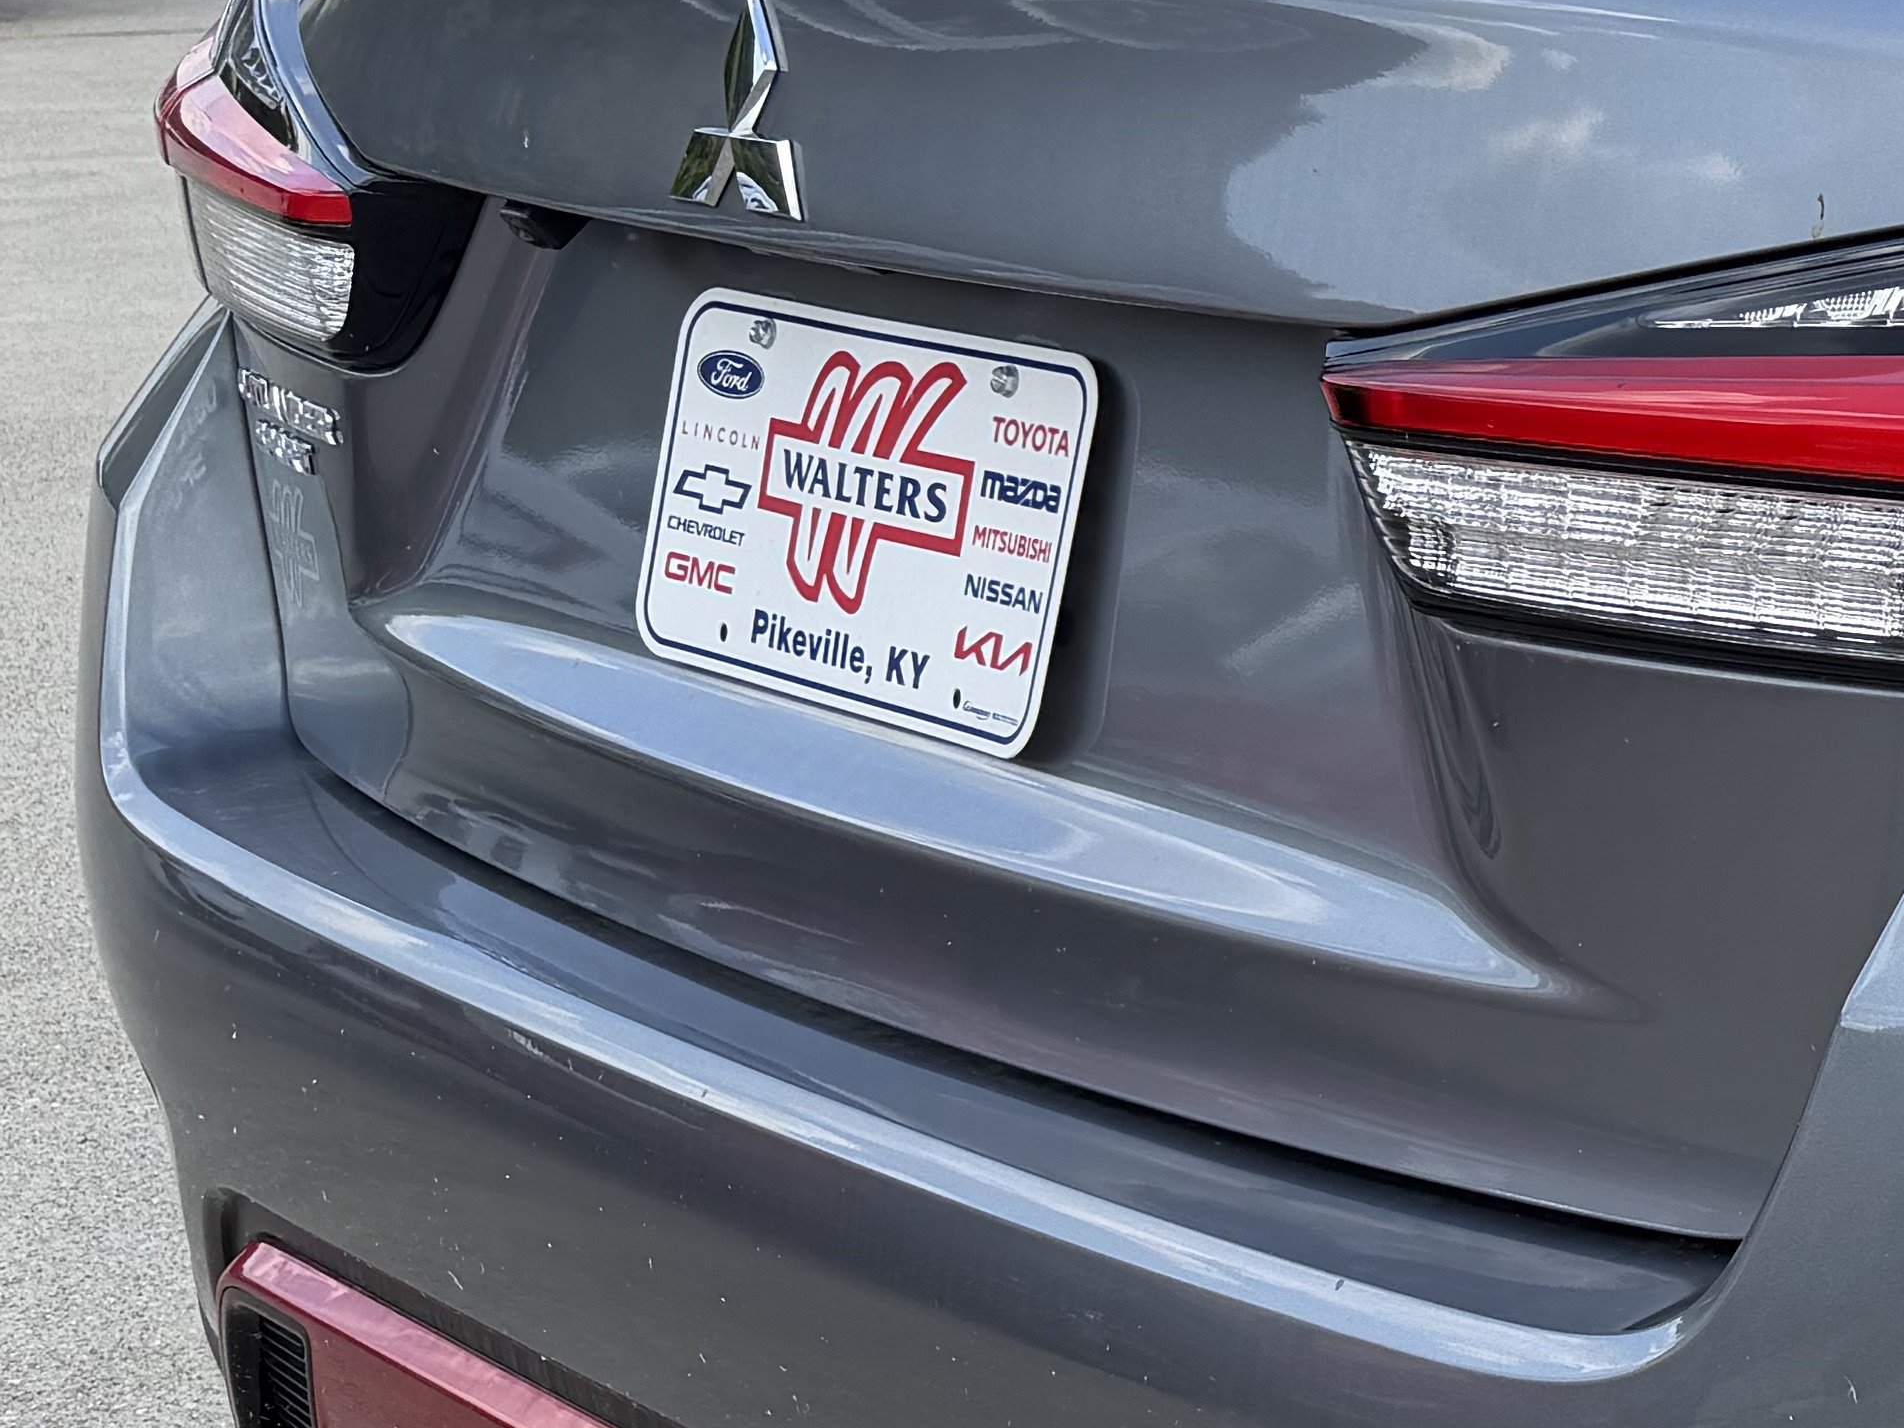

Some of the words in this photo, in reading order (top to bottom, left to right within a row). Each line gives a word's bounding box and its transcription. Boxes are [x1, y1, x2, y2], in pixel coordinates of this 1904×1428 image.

[711, 358, 752, 392] Ford
[681, 420, 761, 451] LINCOLN
[993, 417, 1069, 457] TOYOTA
[784, 449, 947, 522] WALTERS
[668, 516, 745, 546] CHEVROLET
[972, 525, 1052, 564] MITSUBISHI
[665, 552, 735, 594] GMC
[964, 573, 1044, 615] NISSAN
[751, 609, 873, 683] Pikeville,
[886, 646, 931, 689] KY
[954, 626, 1032, 675] KIA
